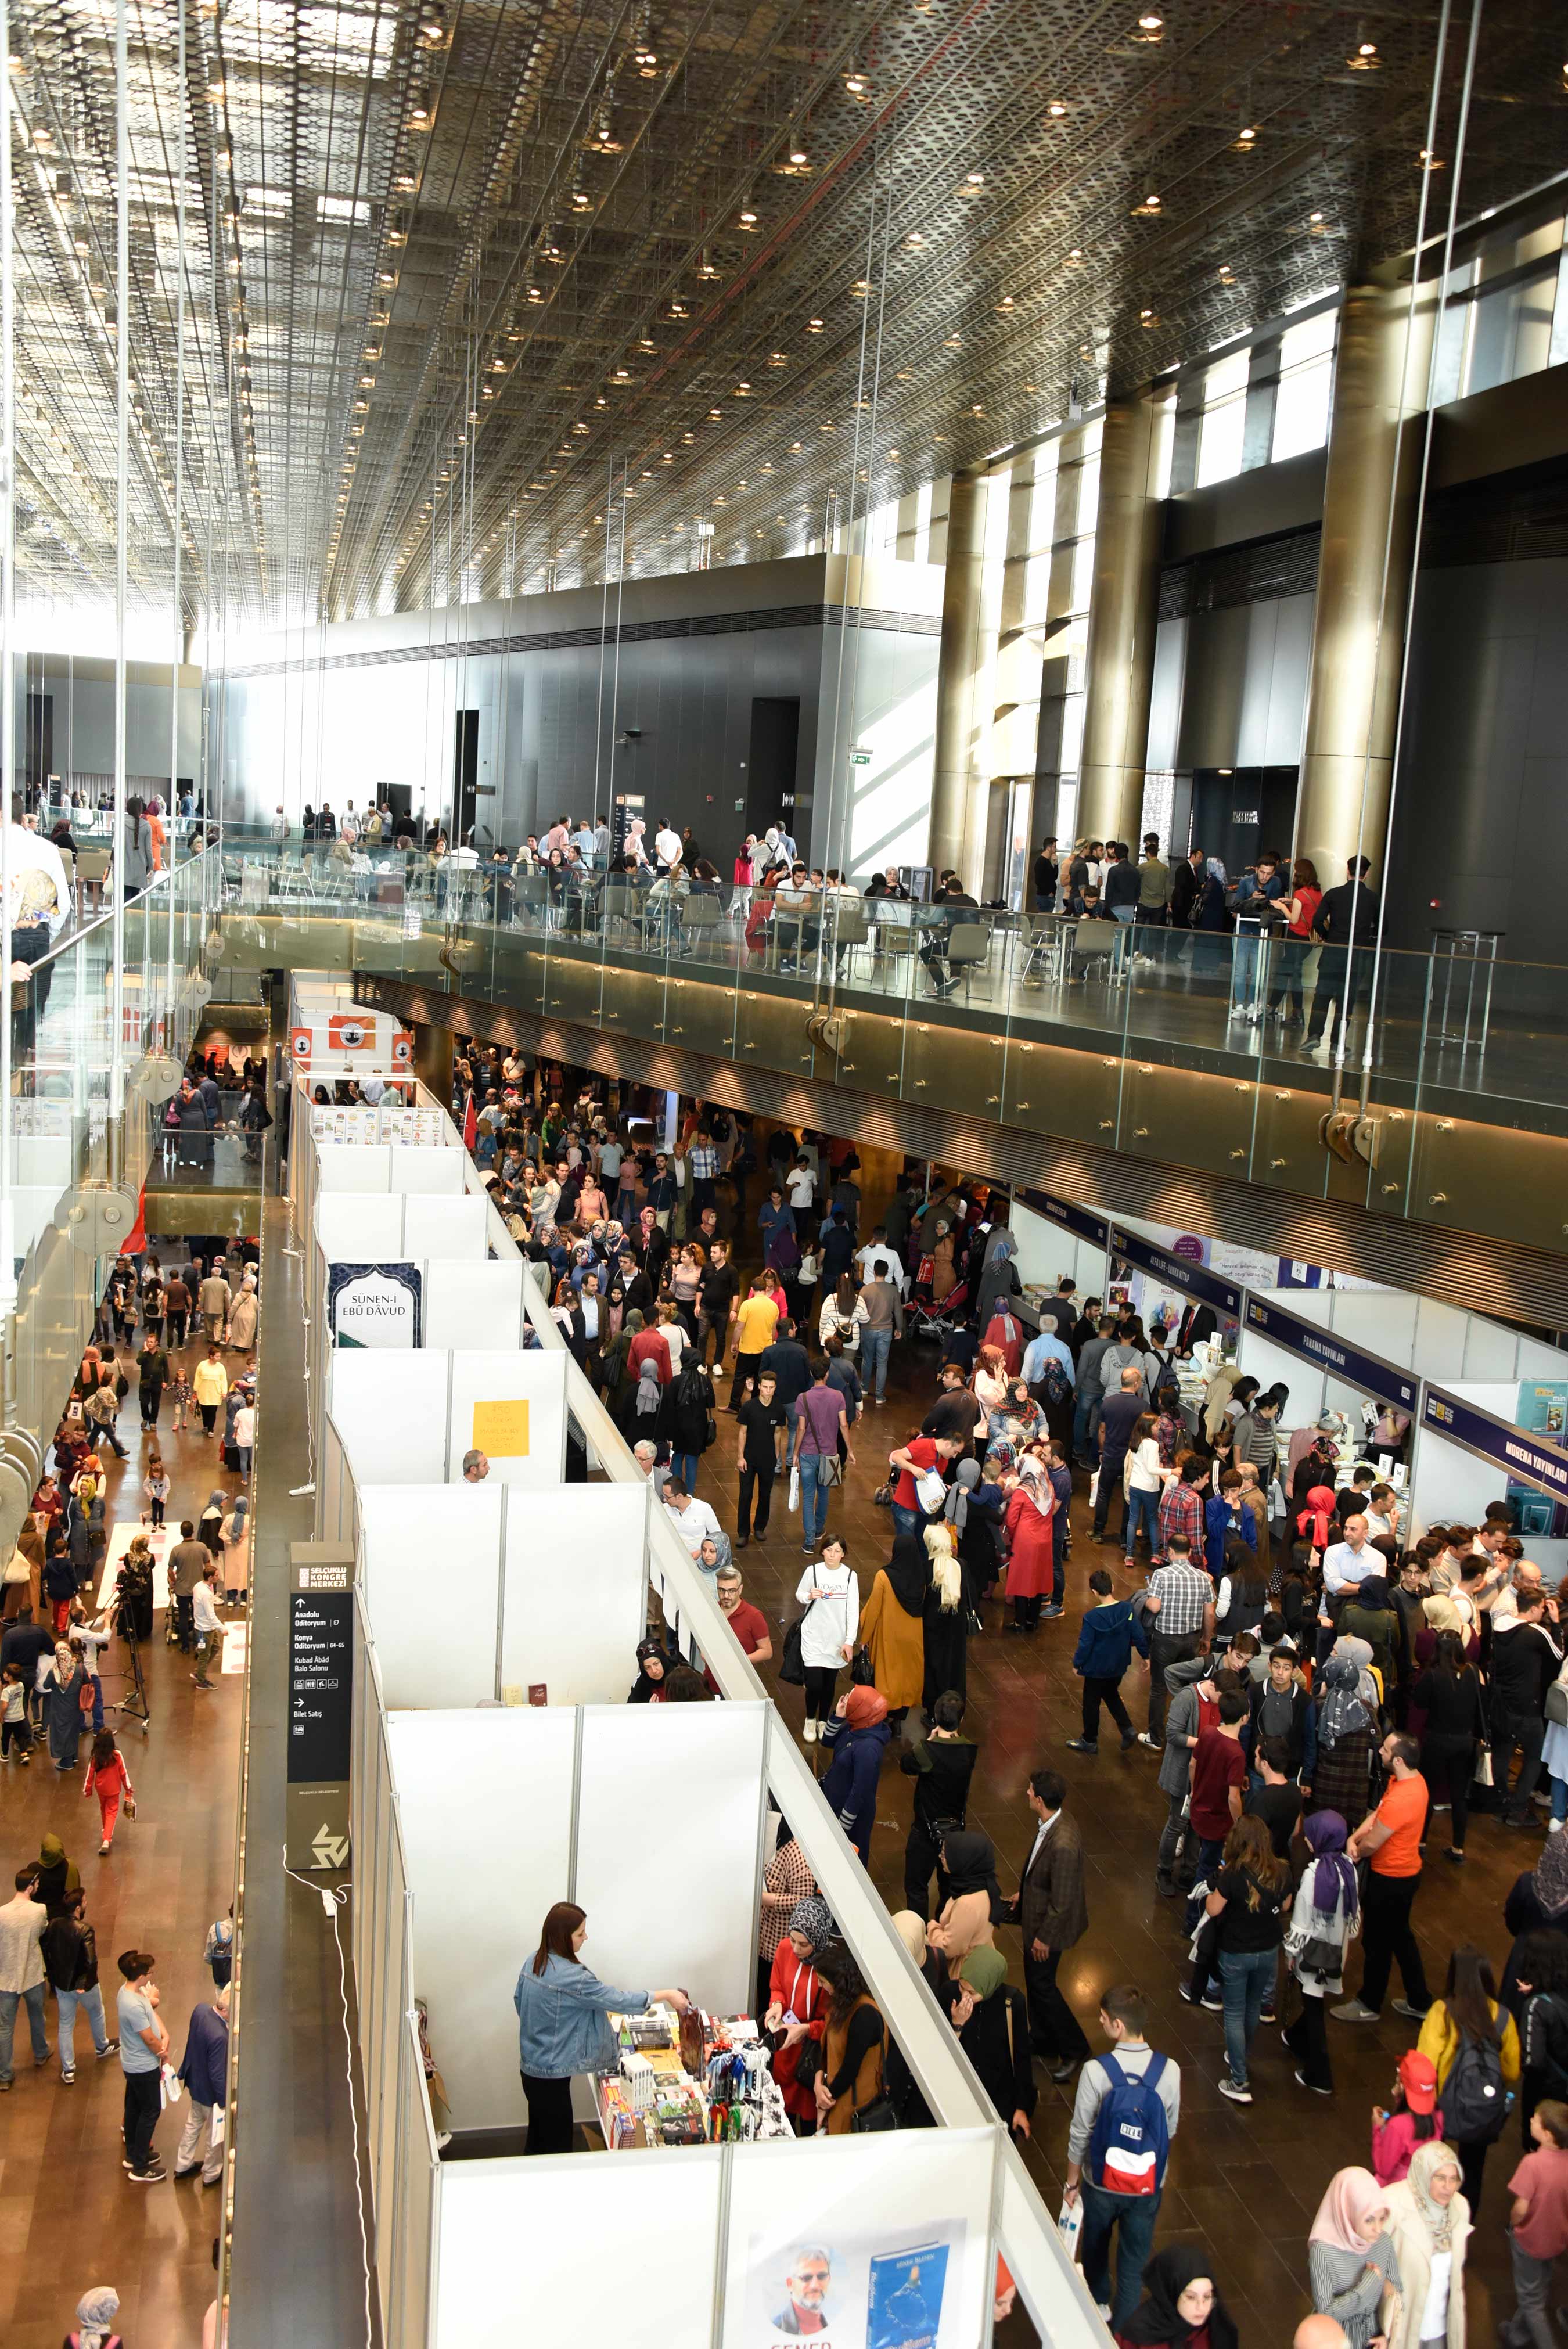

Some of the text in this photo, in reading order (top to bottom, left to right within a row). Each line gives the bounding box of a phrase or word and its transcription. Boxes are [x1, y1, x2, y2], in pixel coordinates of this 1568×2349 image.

[351, 1293, 397, 1304] SÜNEN-İ
[343, 1304, 406, 1316] EBÛ DÂVUD
[1303, 1335, 1346, 1366] PANAMA YAYINLARI
[1505, 1441, 1567, 1484] MORENA YAYINLARI
